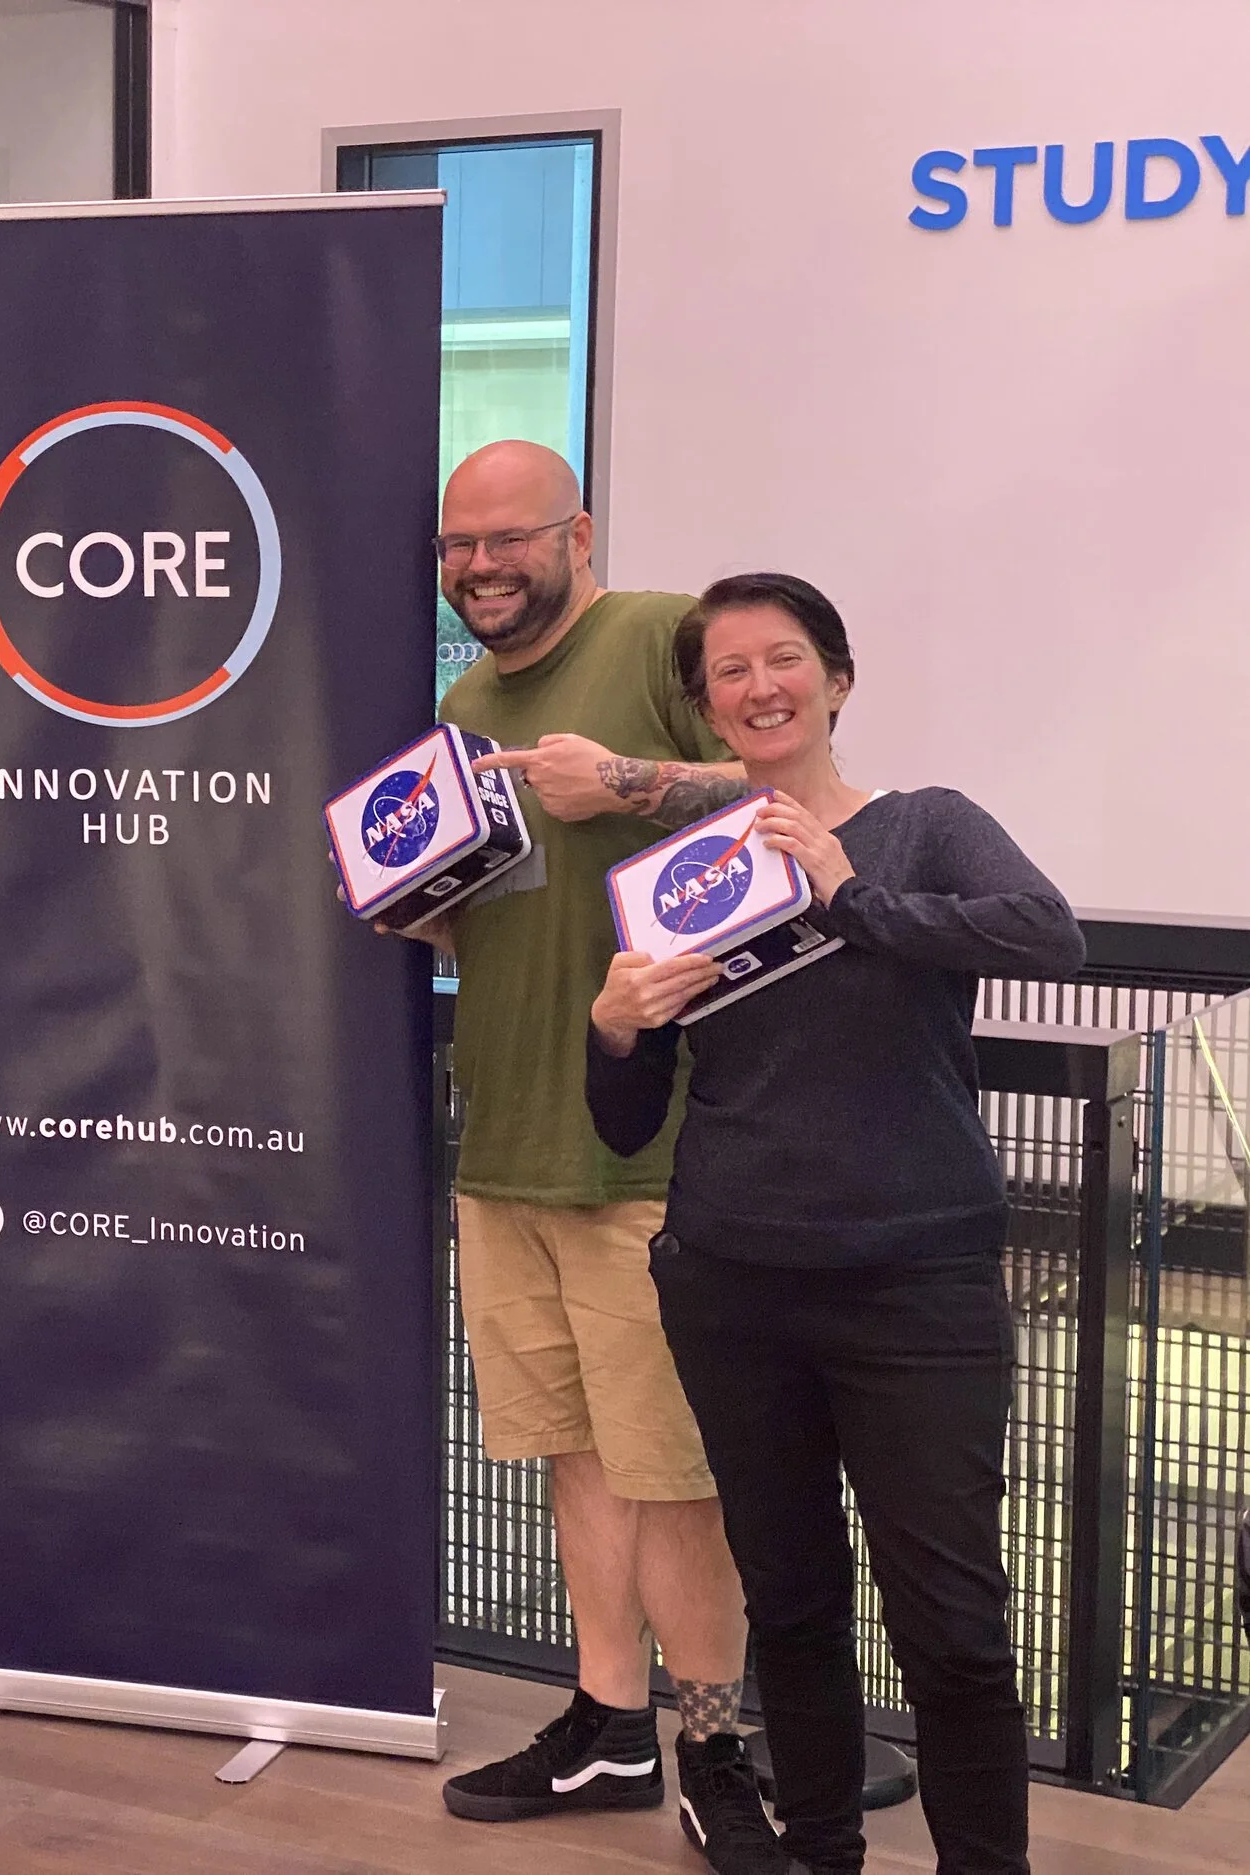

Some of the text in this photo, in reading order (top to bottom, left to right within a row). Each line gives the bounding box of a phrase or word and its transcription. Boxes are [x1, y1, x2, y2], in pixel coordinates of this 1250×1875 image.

[908, 135, 1250, 231] STUDY
[15, 531, 231, 598] CORE
[82, 812, 170, 845] HUB
[365, 792, 436, 847] NASA
[658, 857, 749, 915] NASA
[22, 1210, 306, 1252] @CORE_Innovation
